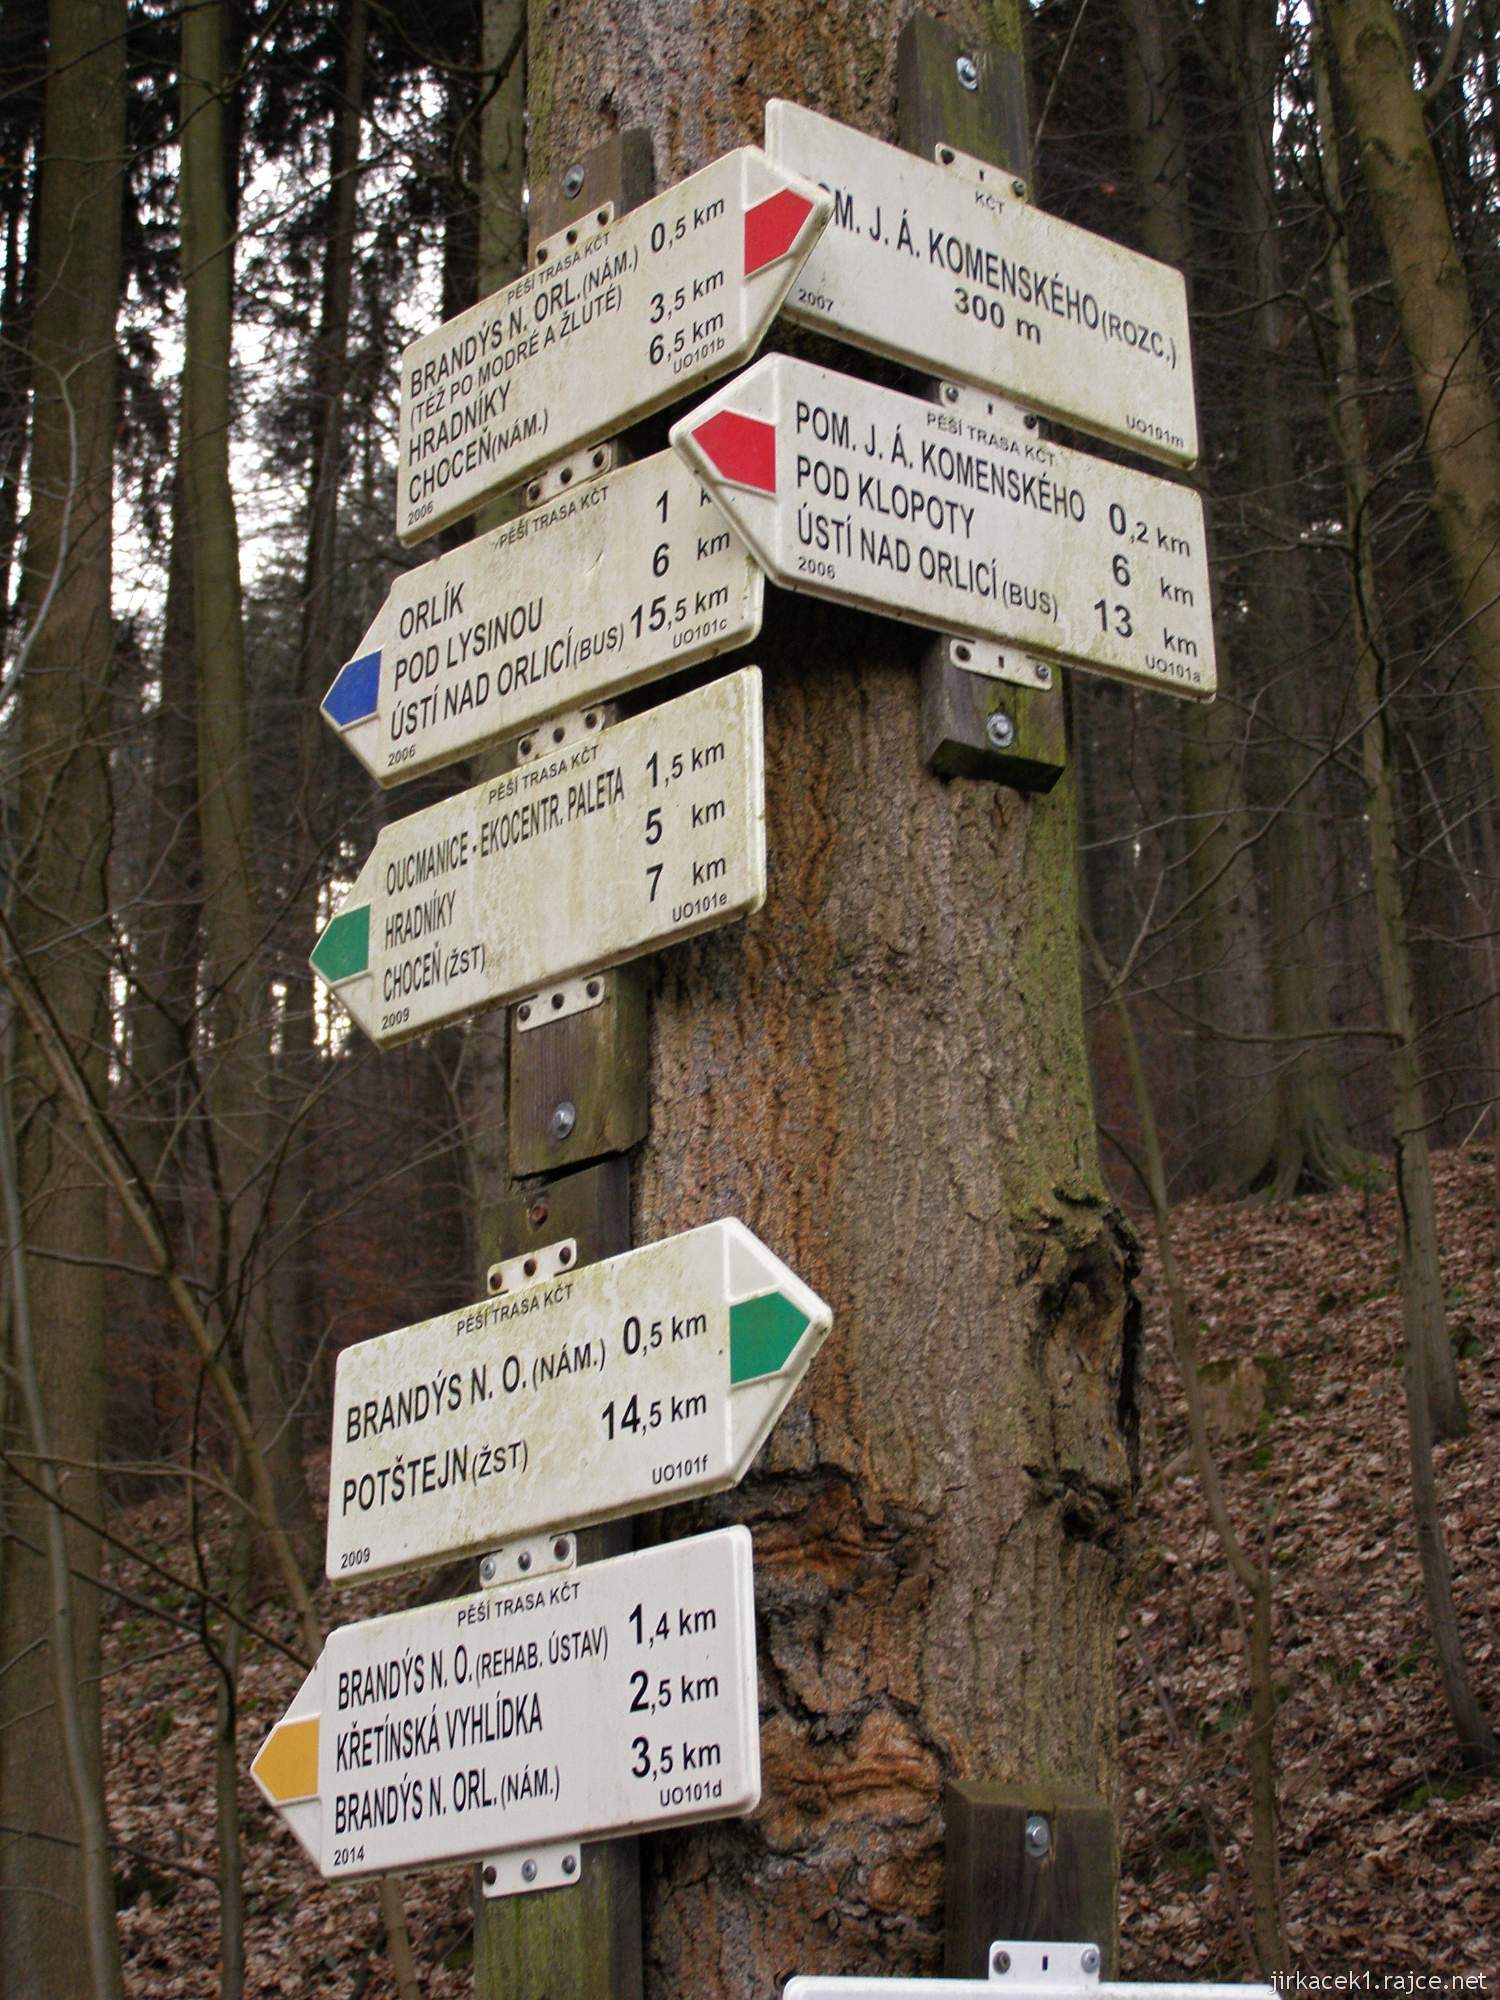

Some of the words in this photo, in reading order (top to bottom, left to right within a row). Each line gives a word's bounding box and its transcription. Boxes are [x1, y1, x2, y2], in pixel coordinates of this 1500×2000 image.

[974, 191, 1004, 215] KČT
[869, 206, 889, 246] J.
[896, 208, 920, 258] Á.
[507, 277, 535, 304] PĚŠÍ
[538, 254, 581, 283] TRASA
[584, 232, 610, 257] KČT
[410, 319, 503, 399] BRANDÝS
[509, 307, 528, 340] N.
[650, 216, 686, 253] 0,5
[693, 198, 724, 231] km
[798, 288, 834, 312] 2007
[954, 287, 1005, 330] 300
[1017, 317, 1041, 345] m
[411, 386, 445, 430] (TÉŽ
[450, 374, 473, 404] PO
[478, 331, 539, 387] MODRÉ
[544, 326, 556, 349] A
[560, 282, 622, 339] ŽLUTÉ)
[649, 329, 685, 366] 6,5
[692, 312, 724, 344] km
[673, 337, 725, 374] UO101b
[409, 379, 511, 467] HRADNÍKY
[650, 287, 685, 324] 3,5
[692, 270, 724, 301] km
[927, 409, 962, 436] PĚŠÍ
[967, 424, 1020, 455] TRASA
[1025, 444, 1056, 467] KČT
[1126, 414, 1184, 448] UO101m
[796, 400, 856, 452] POM.
[864, 424, 883, 460] J.
[891, 423, 913, 470] Á.
[921, 440, 1086, 523] KOMENSKÉHO
[1109, 502, 1149, 545] 0,2
[1156, 527, 1191, 557] km
[407, 500, 434, 527] 2006
[499, 521, 529, 548] PĚŠÍ
[533, 503, 576, 532] TRASA
[580, 486, 609, 511] KČT
[797, 454, 849, 501] POD
[858, 472, 975, 540] KLOPOTY
[1112, 553, 1131, 588] 6
[1160, 576, 1194, 608] km
[400, 580, 464, 640] ORLÍK
[656, 489, 669, 524] 1
[797, 501, 852, 558] ÚSTÍ
[860, 527, 910, 574] NAD
[1093, 598, 1133, 639] 13
[1163, 628, 1198, 658] km
[394, 644, 439, 693] POD
[446, 597, 543, 669] LYSINOU
[652, 543, 670, 577] 6
[697, 532, 730, 561] km
[673, 618, 728, 649] UO101c
[390, 684, 439, 741] ÚSTÍ
[444, 672, 490, 720] NAD
[630, 594, 686, 640] 15,5
[695, 585, 728, 615] km
[1144, 654, 1201, 682] UO101a
[387, 744, 416, 768] 2006
[488, 779, 518, 805] PĚŠÍ
[523, 761, 569, 789] TRASA
[571, 745, 600, 769] KČT
[386, 831, 469, 897] OUCMANICE
[480, 793, 564, 858] EKOCENTR.
[568, 766, 625, 822] PALETA
[646, 751, 683, 787] 1,5
[692, 742, 725, 772] km
[385, 889, 457, 951] HRADNÍKY
[645, 807, 662, 845] 5
[692, 799, 725, 829] km
[646, 862, 664, 902] 7
[692, 857, 727, 886] km
[672, 891, 728, 922] UO101e
[381, 1007, 410, 1031] 2009
[456, 1312, 487, 1336] PĚŠÍ
[492, 1296, 540, 1324] TRASA
[543, 1283, 574, 1309] KČT
[346, 1368, 462, 1444] BRANDÝS
[471, 1364, 493, 1405] N.
[623, 1315, 662, 1356] 0,5
[671, 1313, 707, 1343] km
[601, 1393, 662, 1441] 14,5
[671, 1393, 707, 1423] km
[652, 1454, 708, 1485] UO101f
[340, 1546, 371, 1570] 2009
[457, 1600, 490, 1627] PĚŠÍ
[494, 1591, 546, 1618] TRASA
[549, 1581, 581, 1603] KČT
[338, 1647, 425, 1711] BRANDÝS
[430, 1649, 448, 1691] N.
[548, 1625, 608, 1665] ÚSTAV)
[629, 1602, 670, 1648] 1,4
[679, 1607, 716, 1637] km
[336, 1703, 441, 1773] KŘETÍNSKÁ
[445, 1690, 543, 1750] VYHLÍDKA
[629, 1669, 671, 1715] 2,5
[681, 1674, 719, 1704] km
[335, 1772, 423, 1836] BRANDÝS
[429, 1775, 447, 1818] N.
[631, 1736, 674, 1782] 3,5
[683, 1742, 721, 1771] km
[660, 1779, 723, 1807] UO101d
[333, 1845, 365, 1867] 2014
